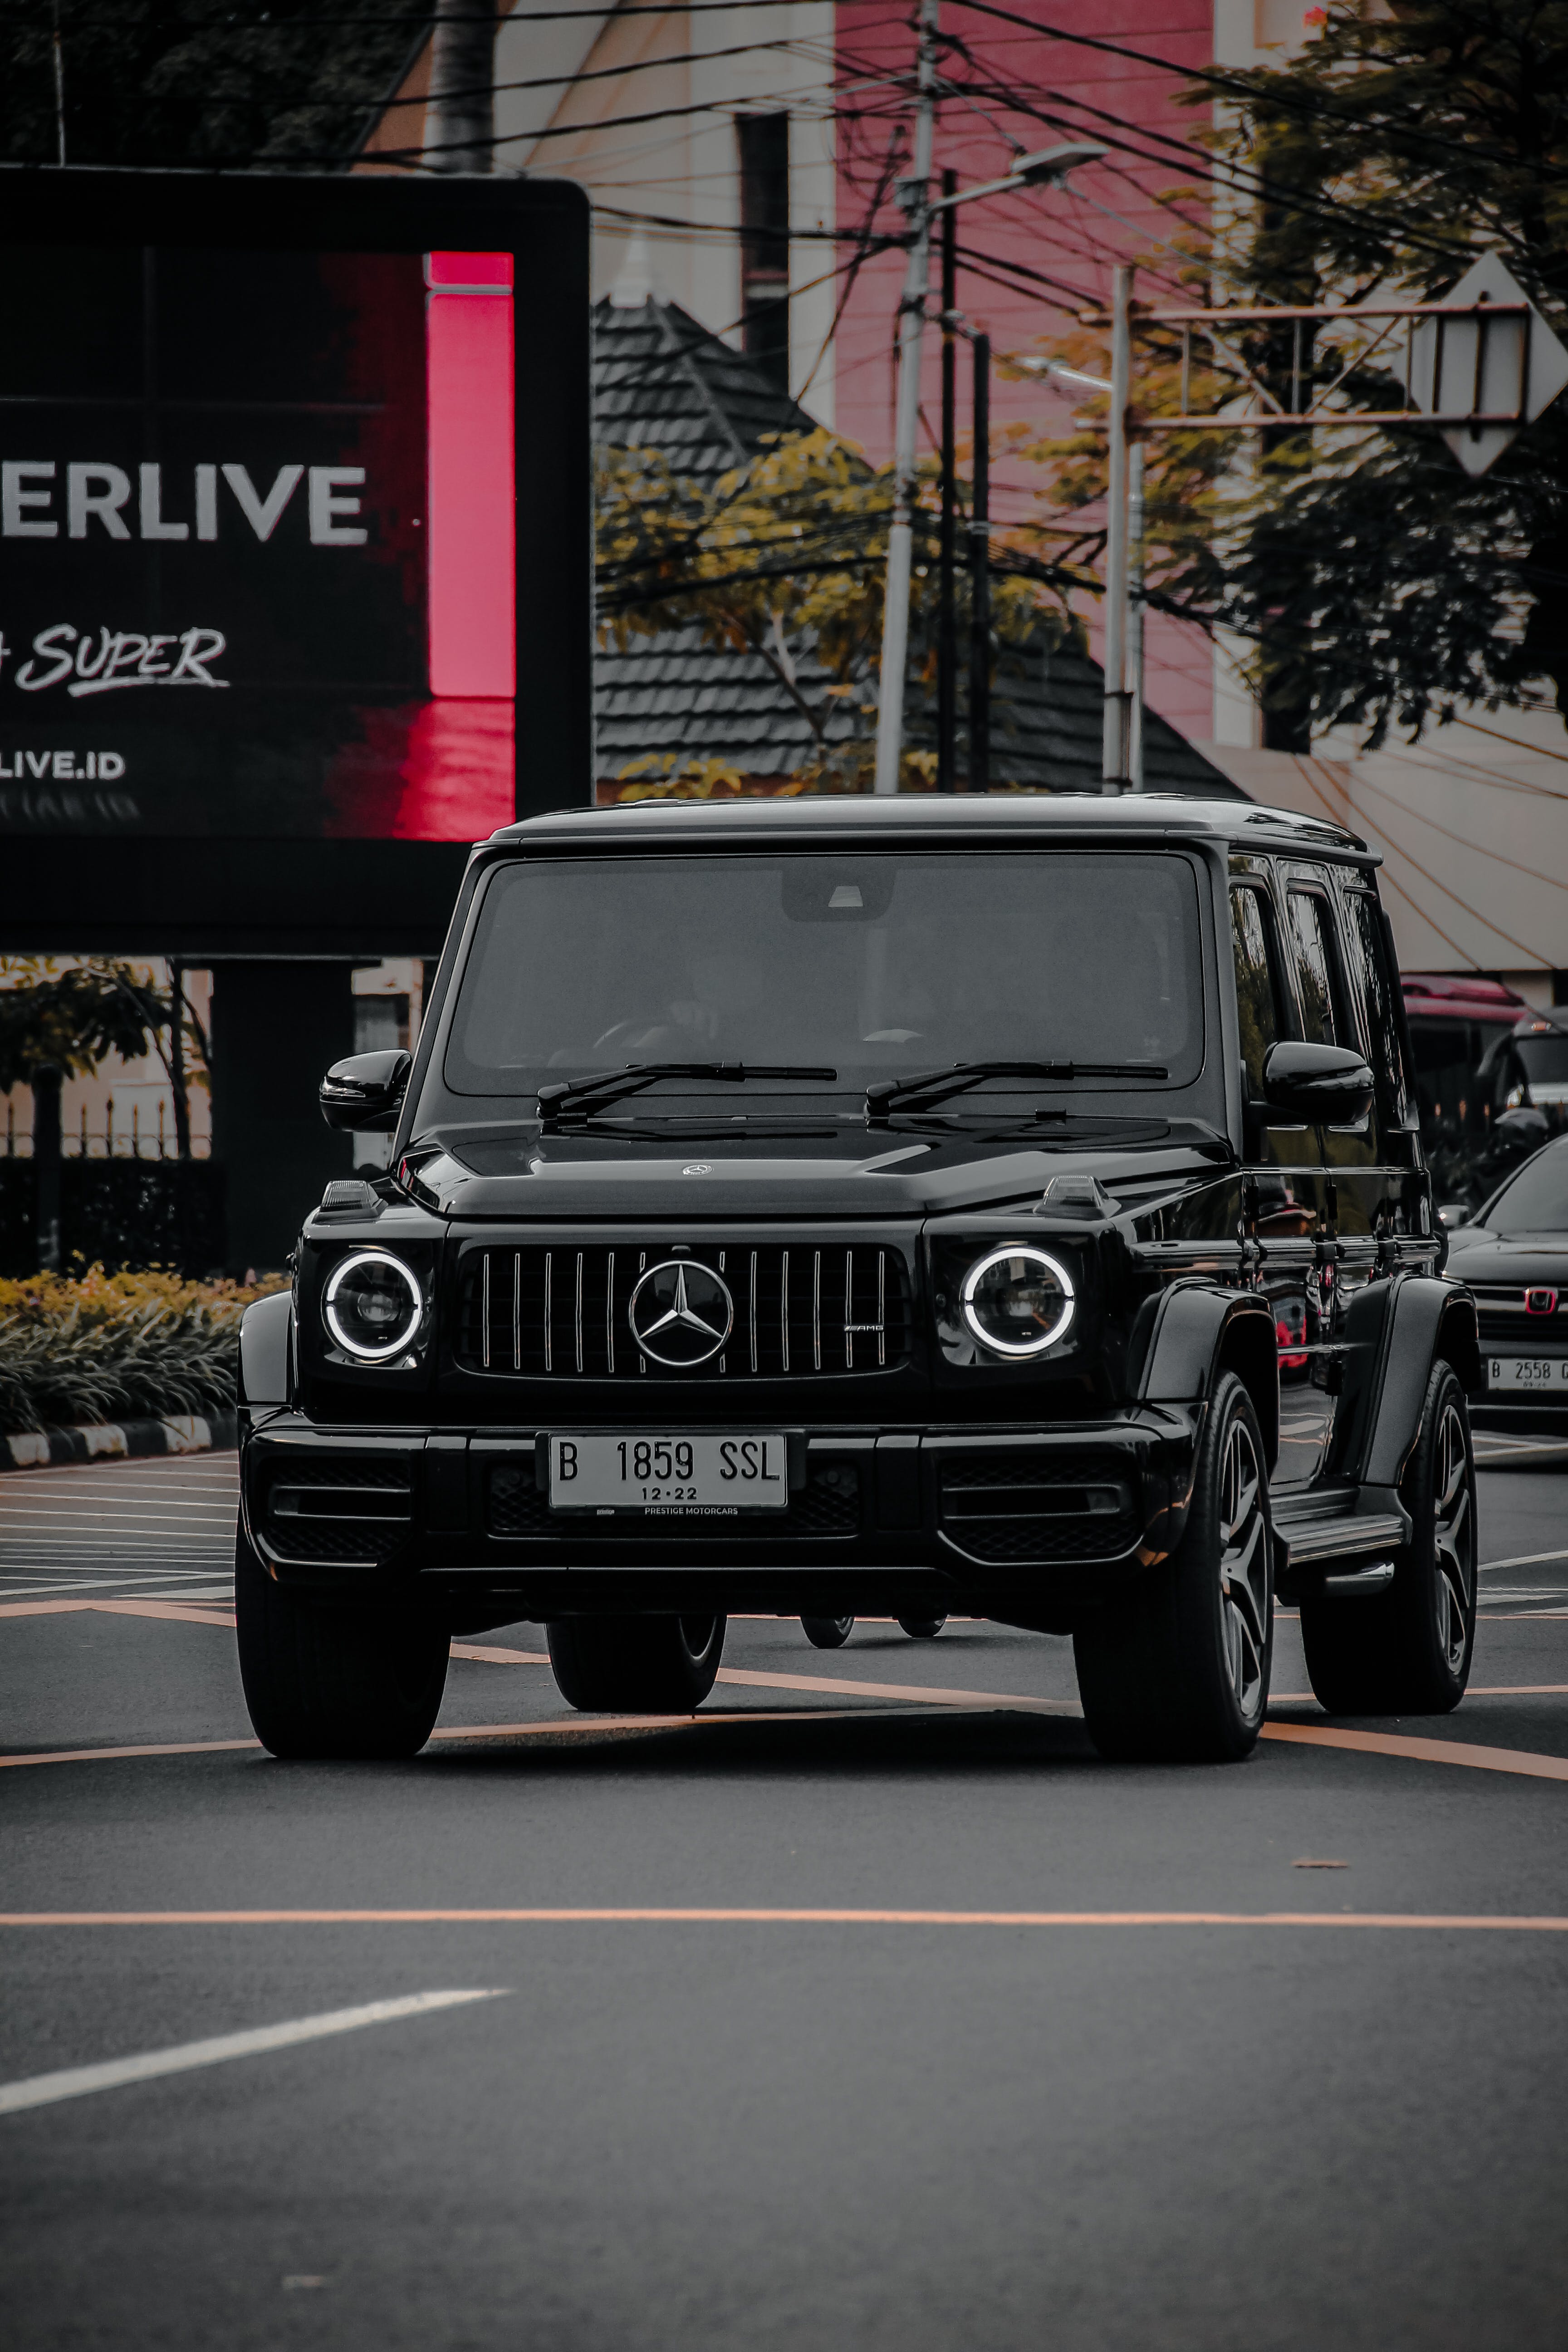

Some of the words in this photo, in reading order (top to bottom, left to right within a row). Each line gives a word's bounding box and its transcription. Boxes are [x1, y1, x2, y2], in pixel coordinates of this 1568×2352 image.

[1, 460, 368, 545] ERLIVE
[15, 623, 230, 697] SUPER
[0, 750, 126, 780] LIVE.ID
[1492, 1362, 1500, 1377] B
[1516, 1362, 1551, 1379] 2558
[559, 1441, 578, 1480] B
[617, 1441, 694, 1480] 1859
[720, 1441, 780, 1480] SSL
[645, 1507, 684, 1515] PRESTIGE
[686, 1507, 738, 1515] MOTORCARS
